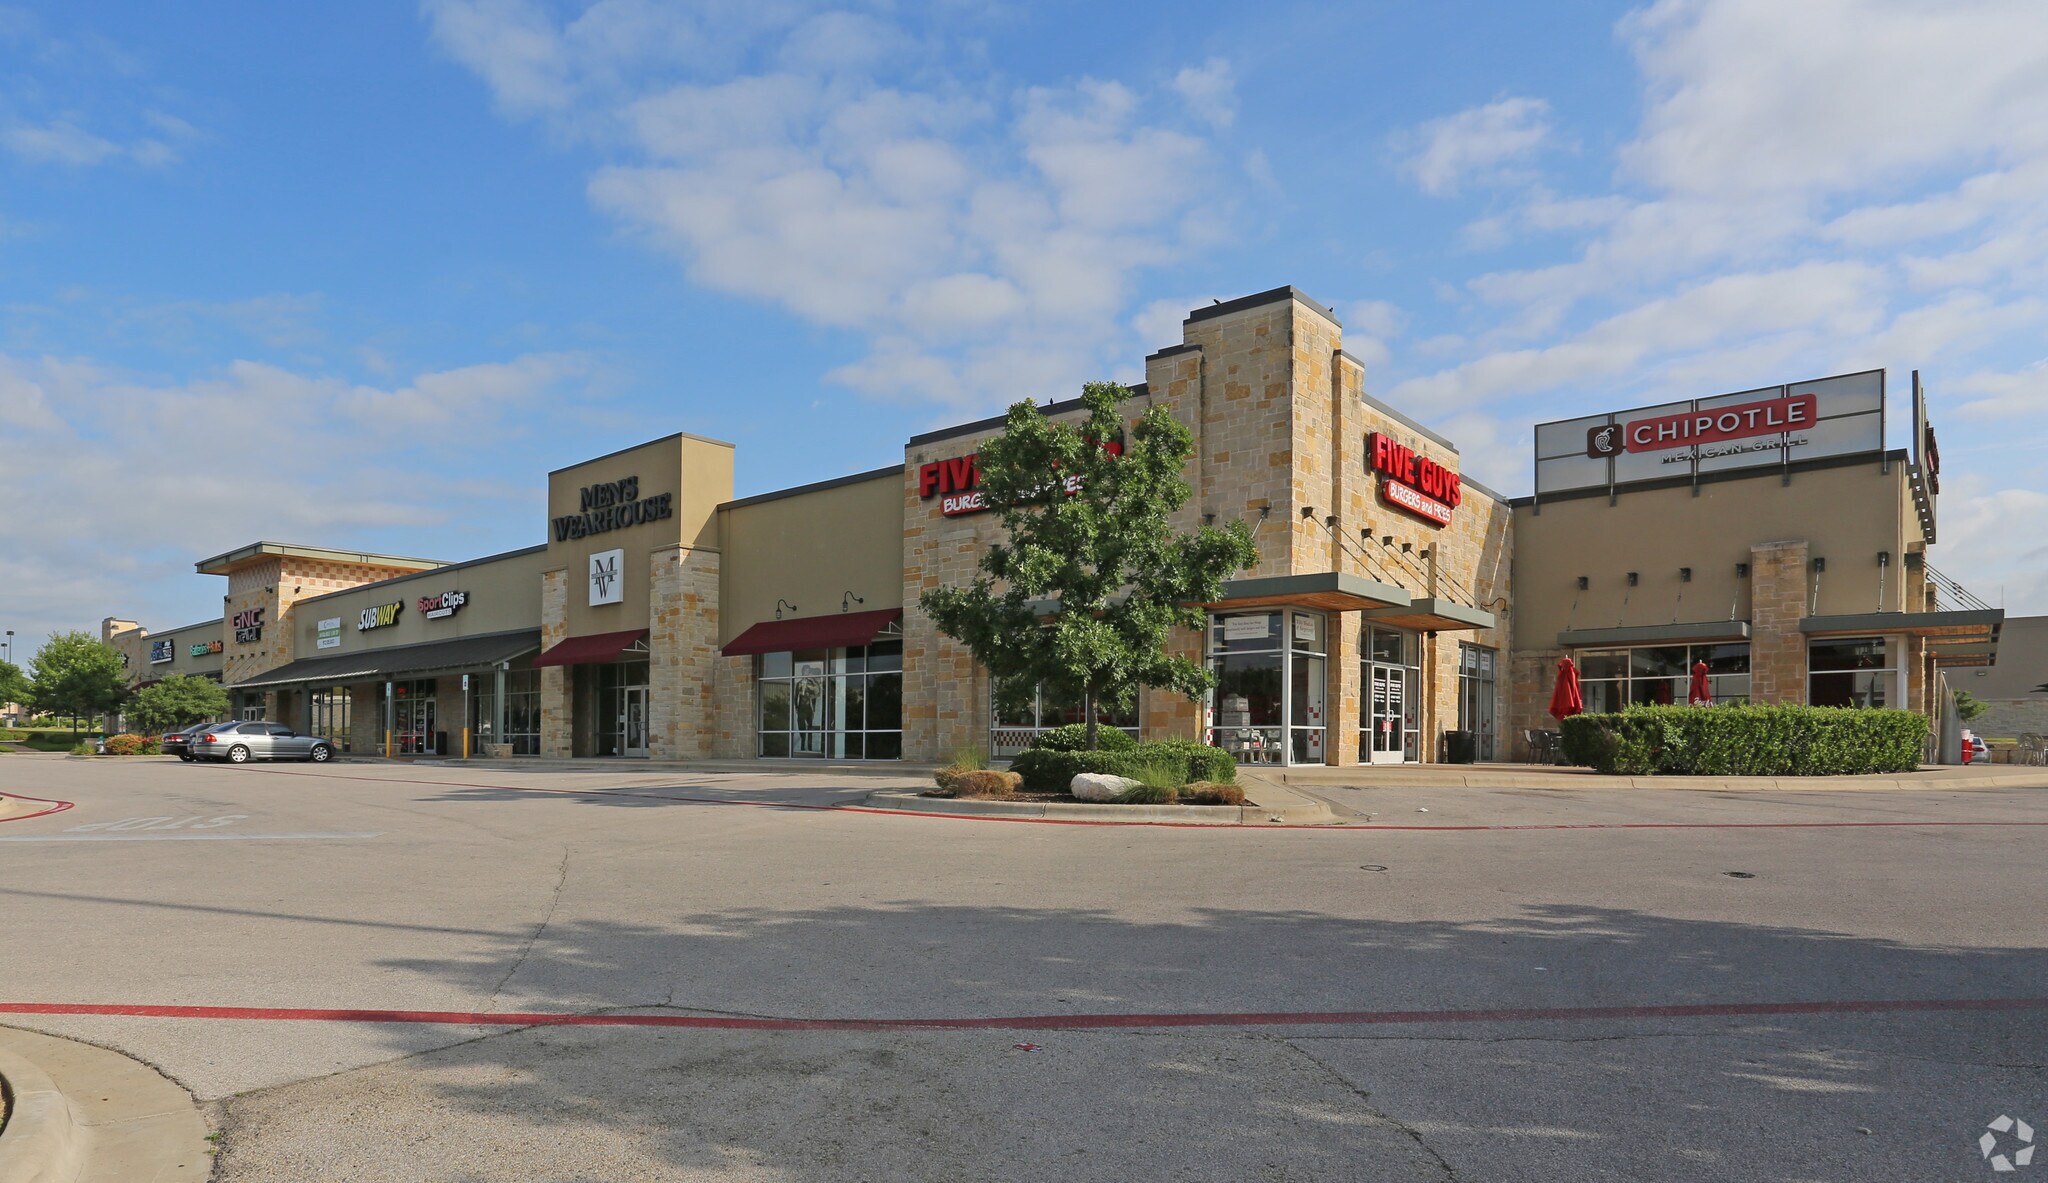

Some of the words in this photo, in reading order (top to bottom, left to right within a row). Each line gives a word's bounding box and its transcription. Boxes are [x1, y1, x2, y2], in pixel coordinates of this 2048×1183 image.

[1633, 401, 1807, 445] CHIPOTLE
[1661, 444, 1742, 464] MEXICAN
[1752, 435, 1808, 451] GRILL
[1371, 432, 1414, 484] FIVE
[1418, 456, 1462, 506] GUYS
[580, 475, 638, 512] MEN'S
[1390, 482, 1420, 509] BURGERS
[1421, 501, 1433, 515] and
[1433, 503, 1451, 522] FRIES
[552, 493, 672, 541] WEARHOUSE
[232, 608, 261, 629] GNC
[358, 602, 401, 630] SUBWAY
